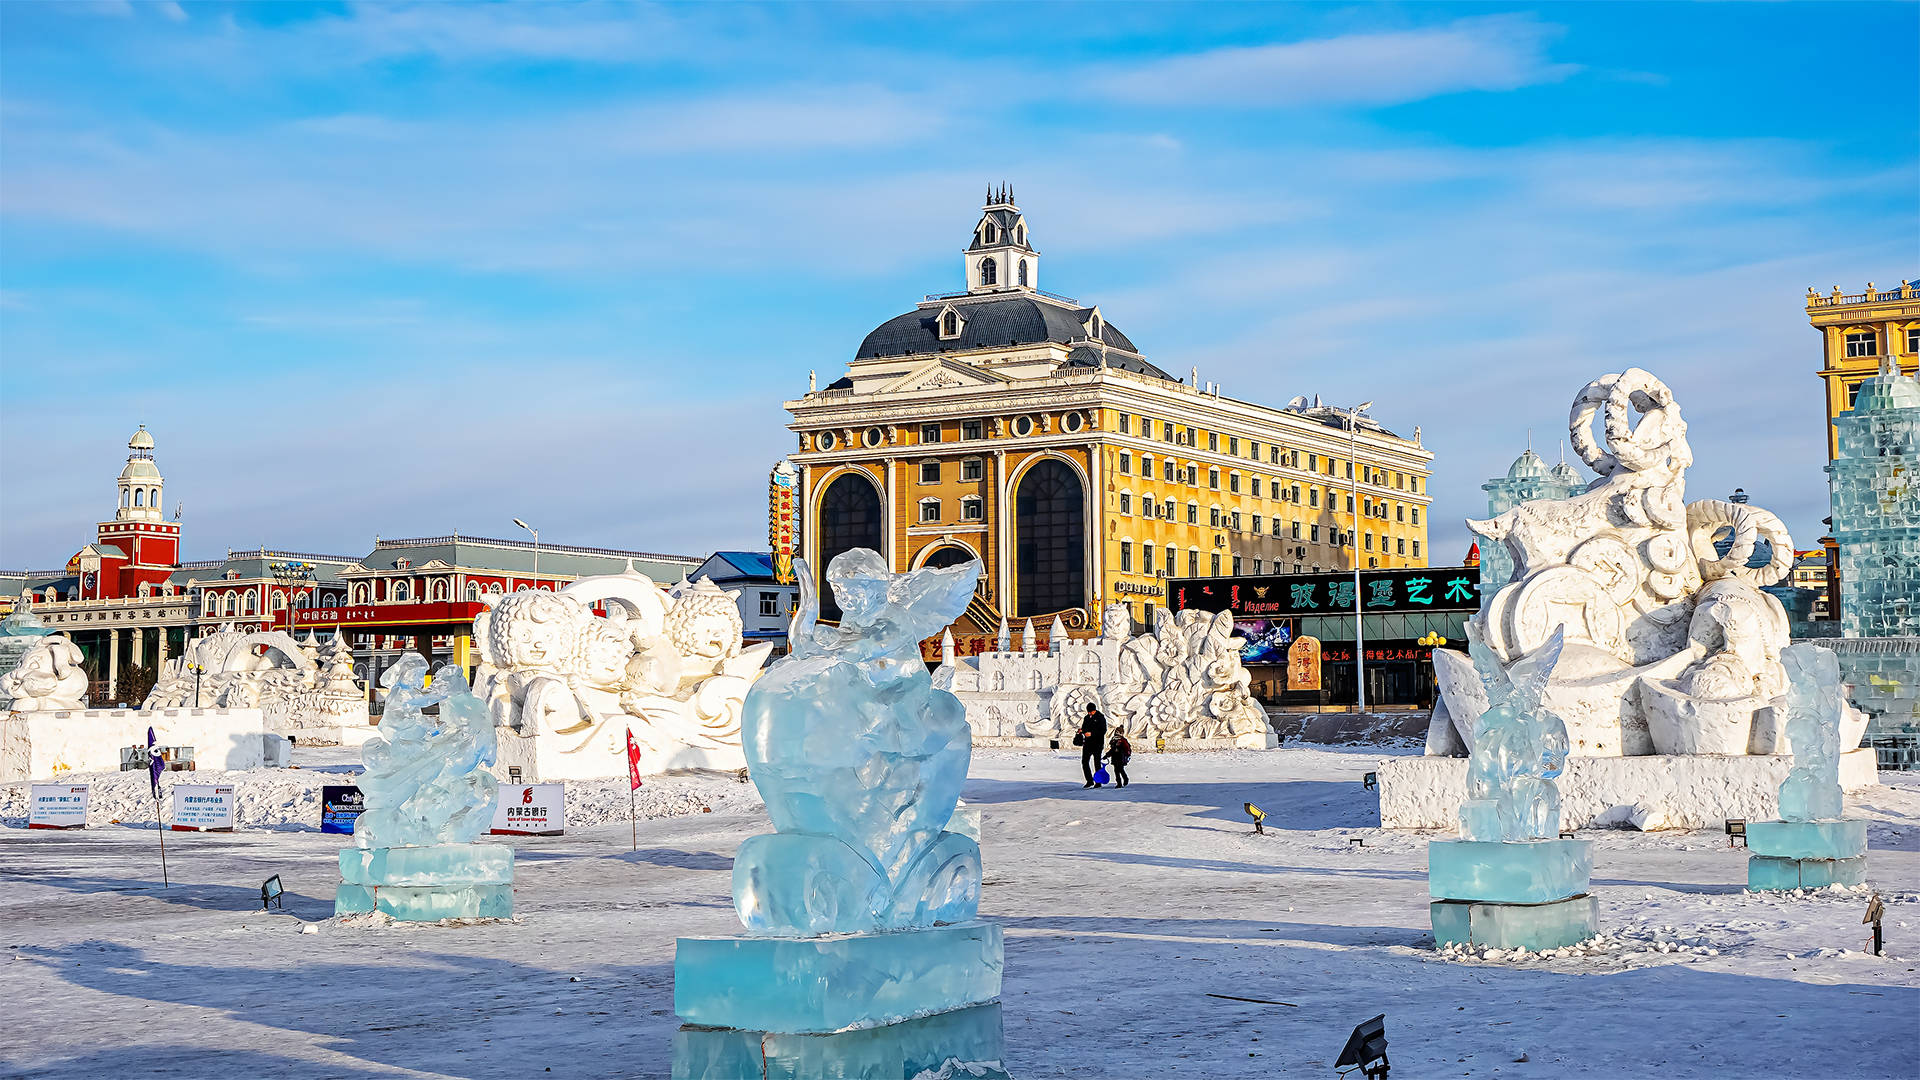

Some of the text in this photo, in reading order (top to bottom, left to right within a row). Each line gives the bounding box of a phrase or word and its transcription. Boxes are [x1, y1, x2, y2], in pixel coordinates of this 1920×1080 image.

[1244, 600, 1279, 614] Изделие
[302, 610, 338, 621] 中国石油
[507, 807, 548, 817] 内蒙古银行
